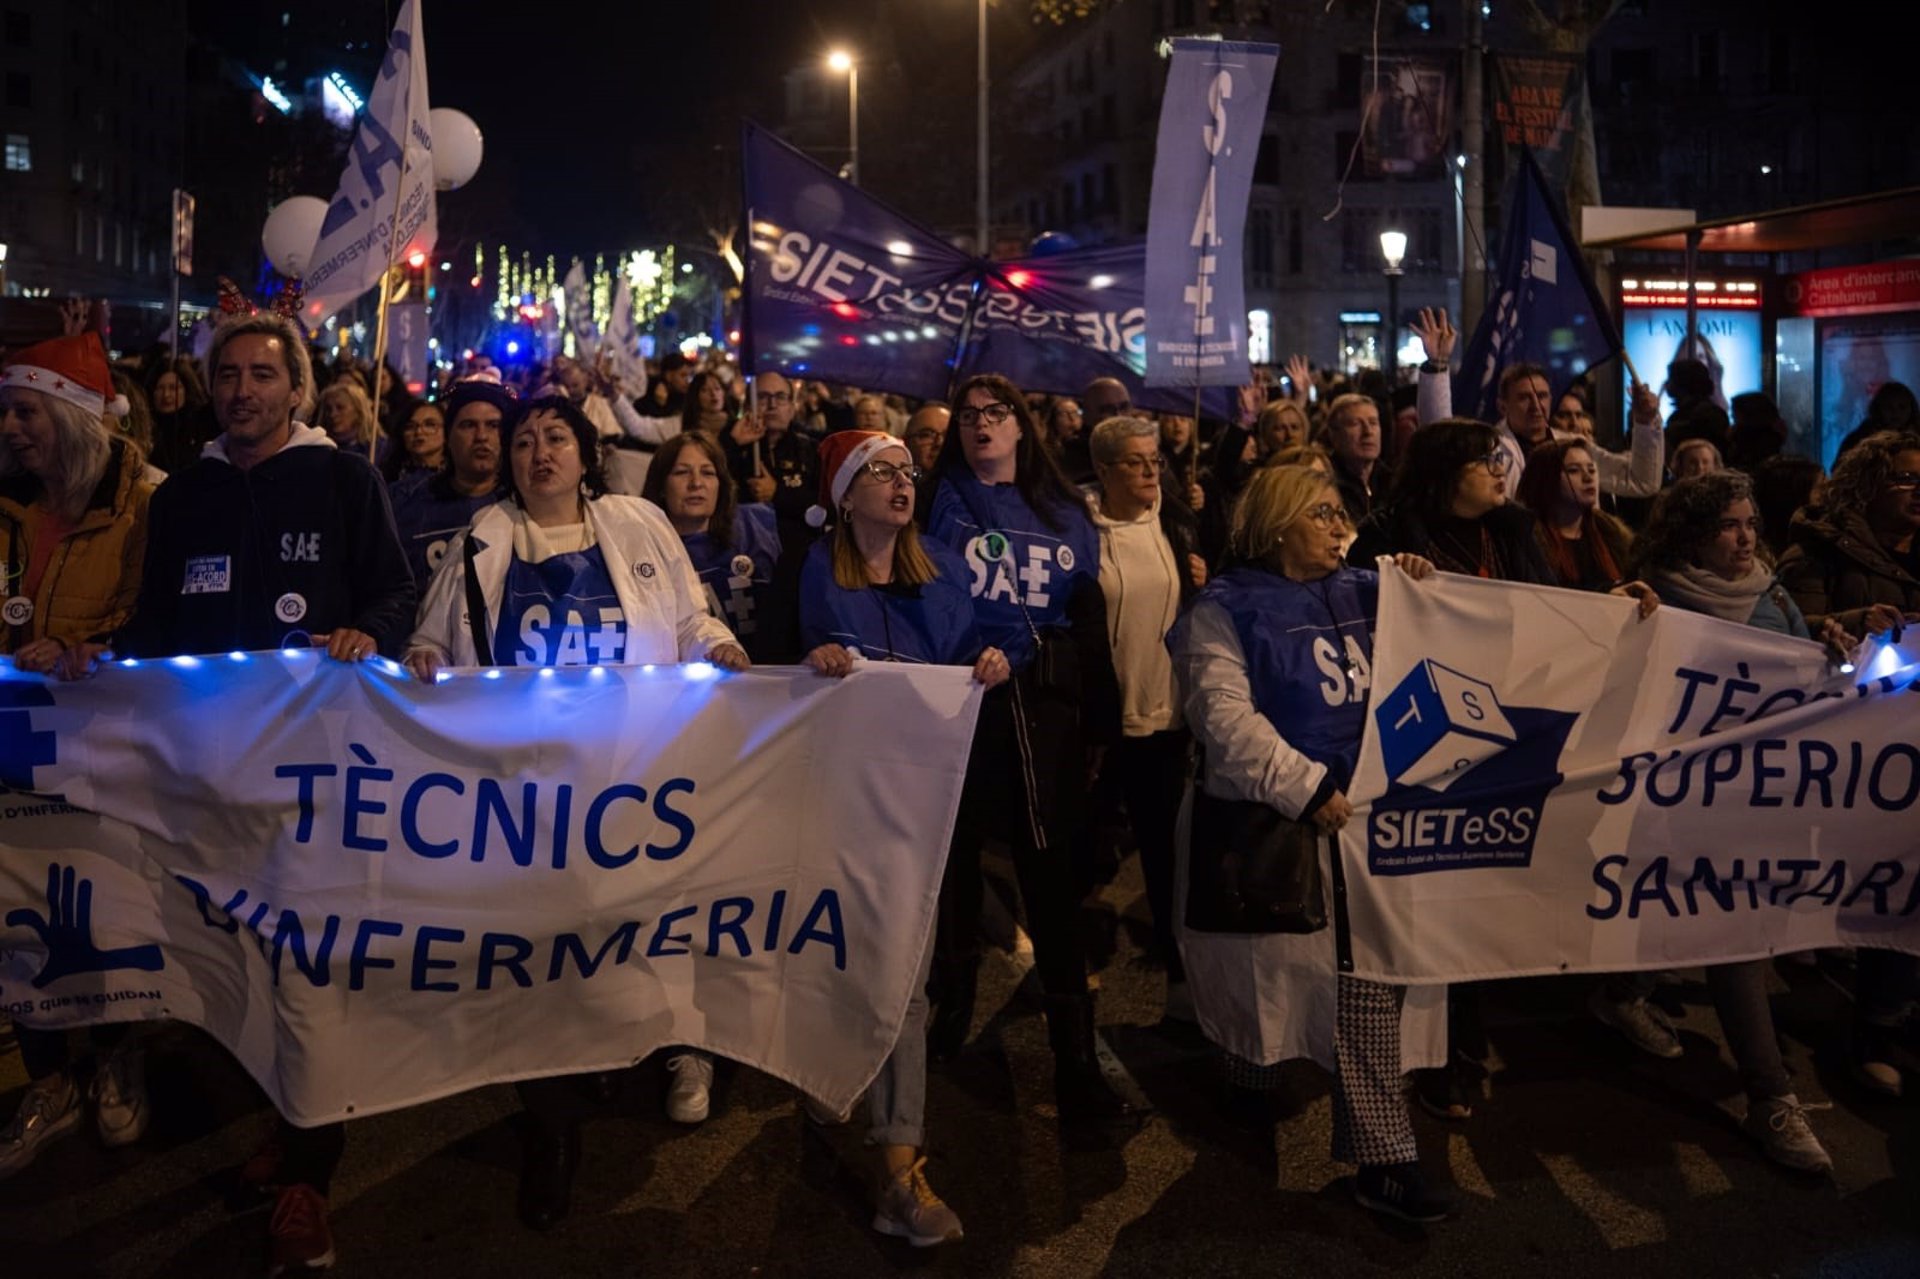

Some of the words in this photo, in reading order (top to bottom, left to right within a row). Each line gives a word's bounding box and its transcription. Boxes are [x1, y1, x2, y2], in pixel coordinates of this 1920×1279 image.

[1808, 290, 1878, 306] Catalunya
[275, 743, 696, 869] TÈCNICS
[1374, 807, 1535, 849] SIETeSS
